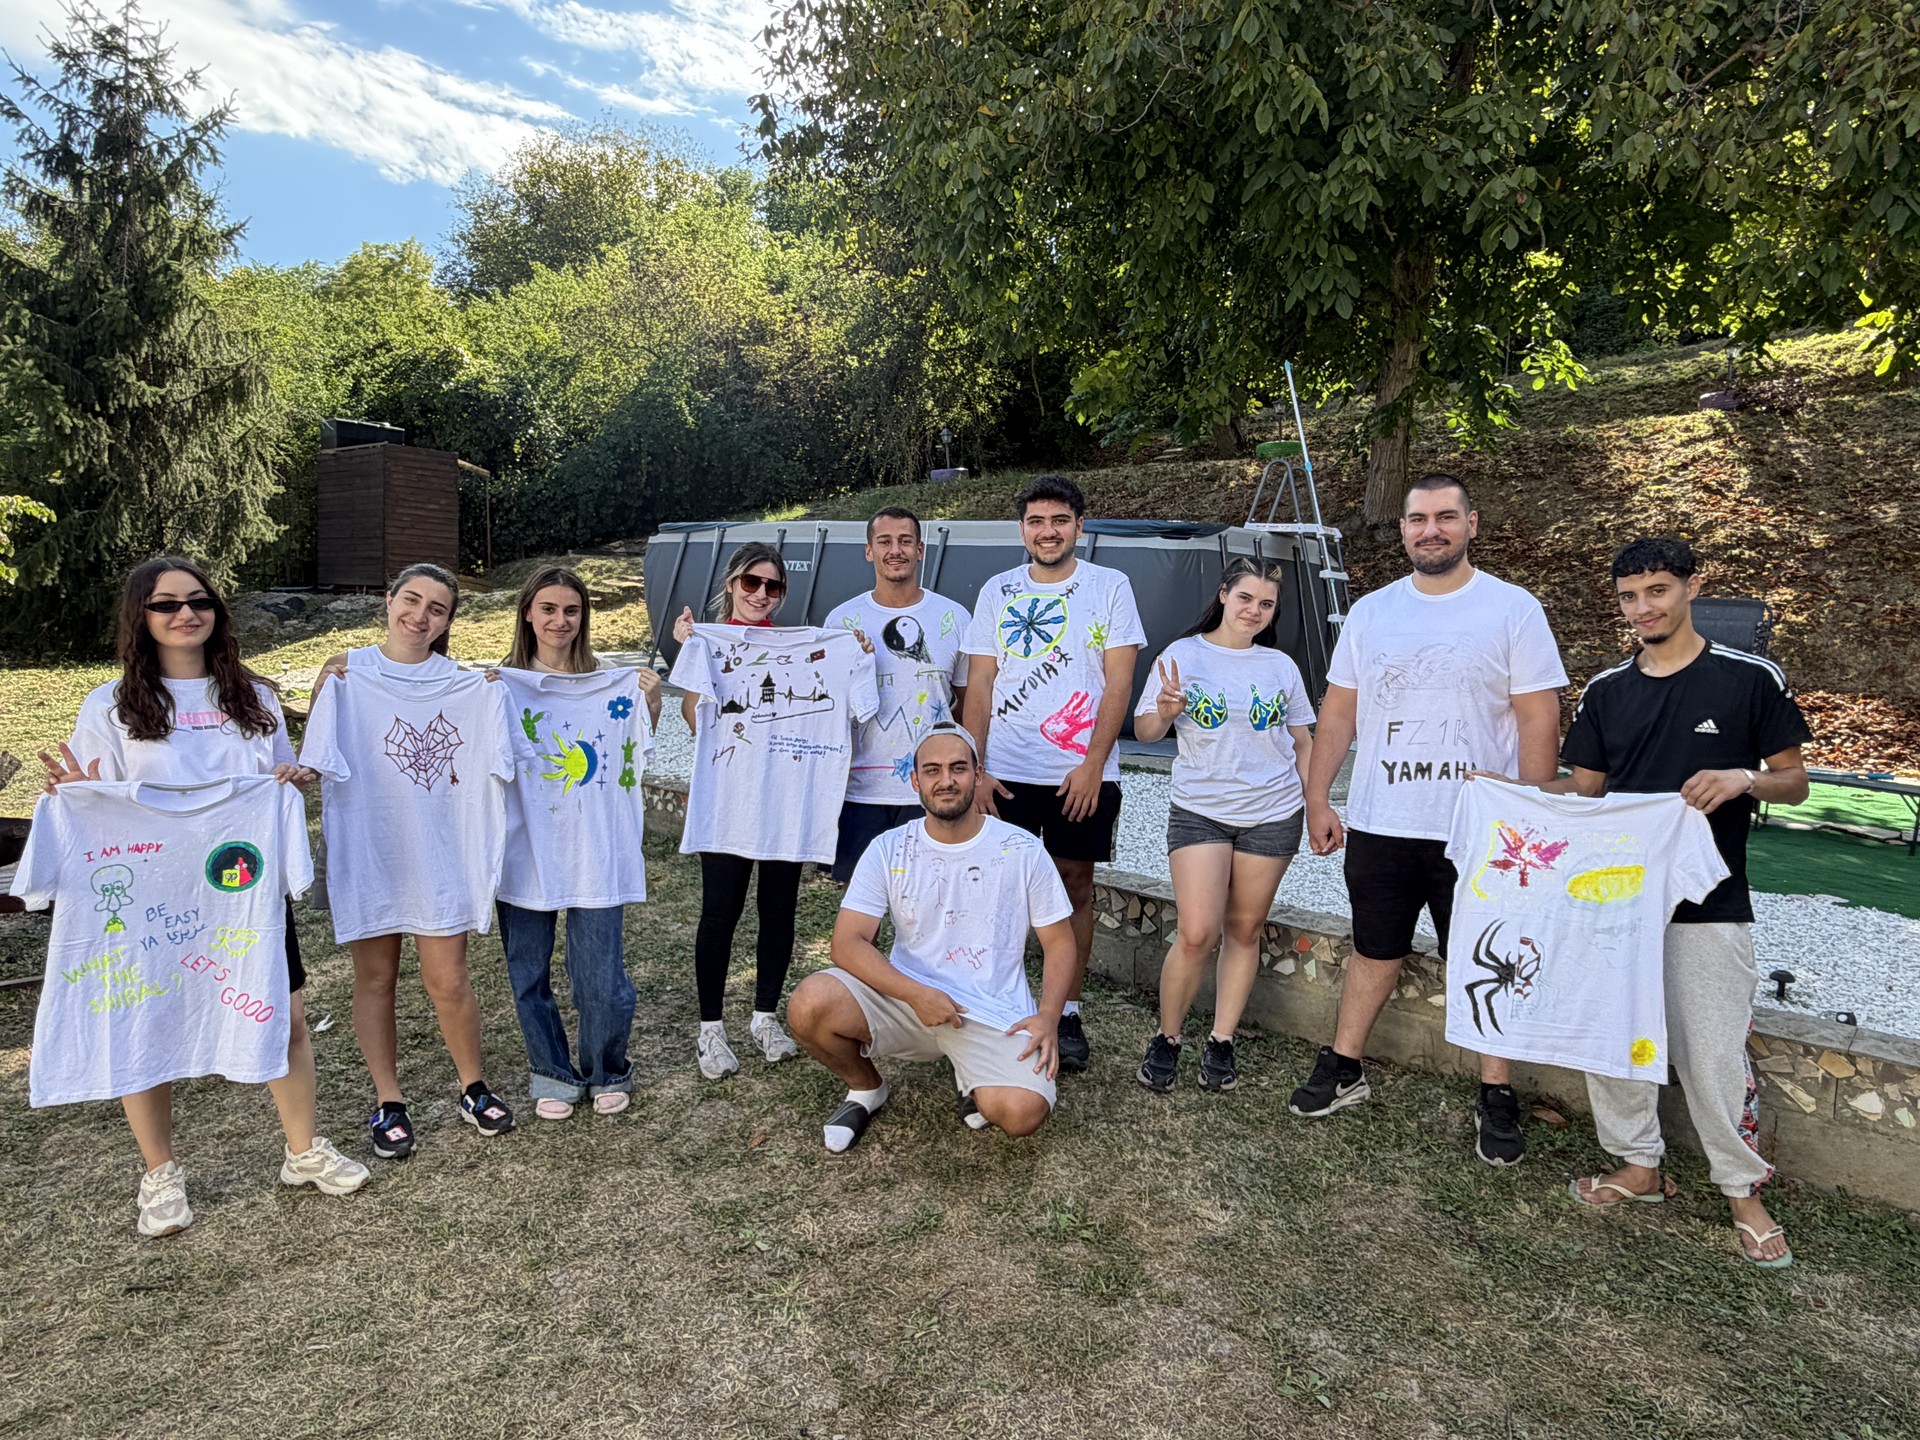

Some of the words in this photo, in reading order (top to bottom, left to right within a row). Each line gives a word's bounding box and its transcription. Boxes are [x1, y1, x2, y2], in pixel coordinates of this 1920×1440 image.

[783, 560, 811, 571] NTEX
[83, 851, 95, 862] I
[100, 845, 121, 858] AM
[127, 842, 163, 854] HAPPY
[145, 902, 168, 922] BE
[165, 908, 199, 929] EASY
[140, 936, 158, 951] YA
[61, 944, 128, 984] WHAT
[220, 987, 274, 1023] GOOO
